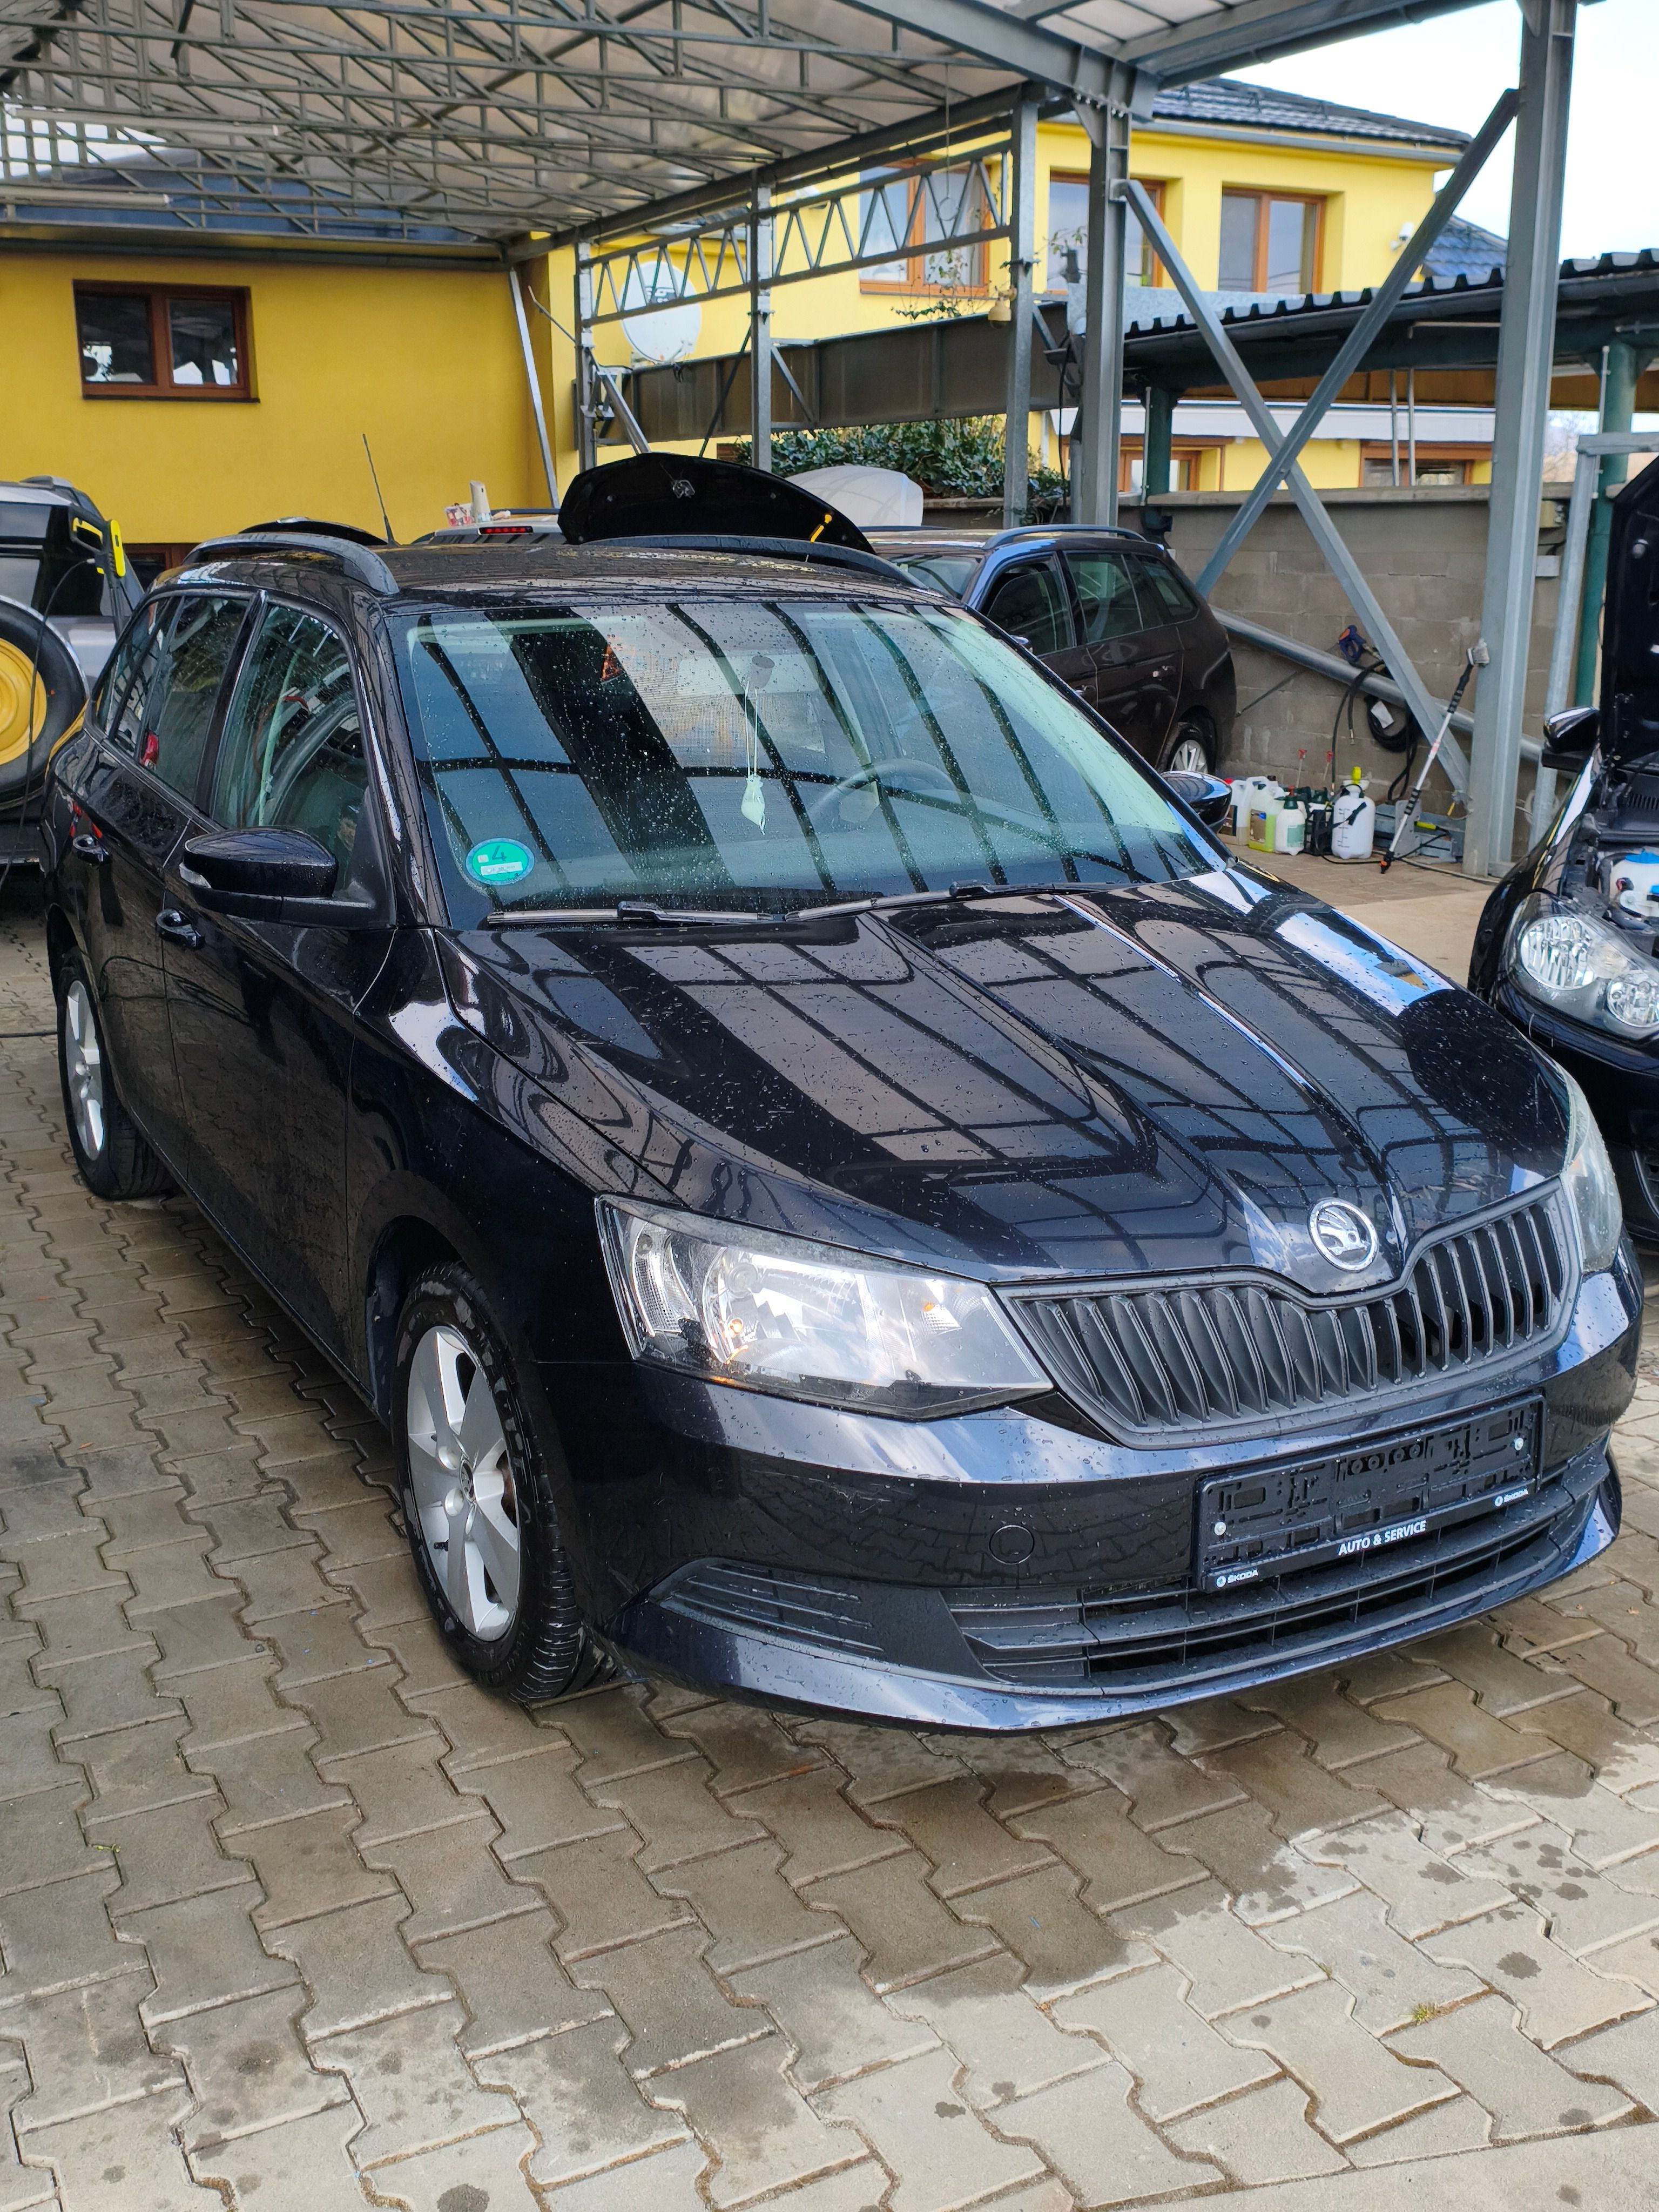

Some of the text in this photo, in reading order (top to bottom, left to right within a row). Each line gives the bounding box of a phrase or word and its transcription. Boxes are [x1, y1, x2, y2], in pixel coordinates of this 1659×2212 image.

[491, 845, 507, 861] 4
[1338, 1520, 1426, 1556] AUTO & SERVICE
